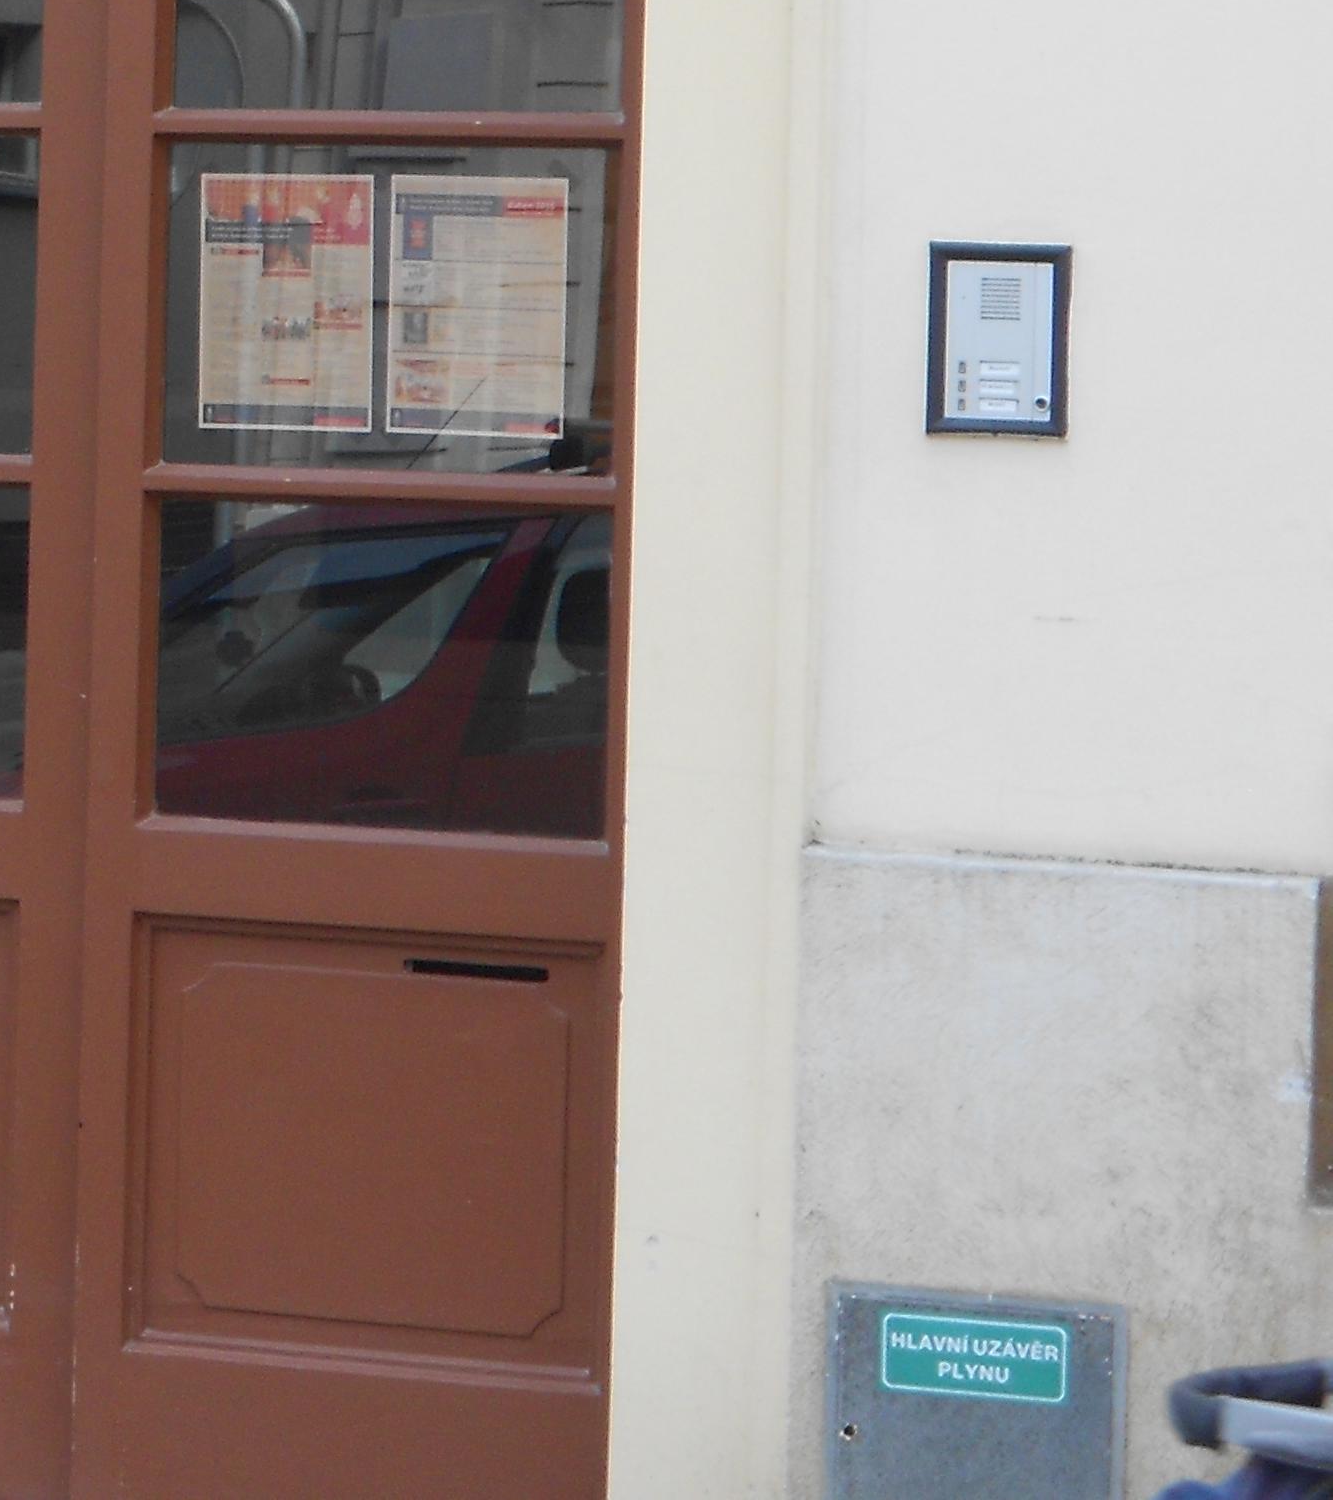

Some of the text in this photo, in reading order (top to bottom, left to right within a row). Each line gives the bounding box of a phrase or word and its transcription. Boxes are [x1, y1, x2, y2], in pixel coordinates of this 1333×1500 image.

[890, 1332, 1059, 1362] HLAVNÍ UZÁVĚR
[937, 1360, 1010, 1384] PLYNU
